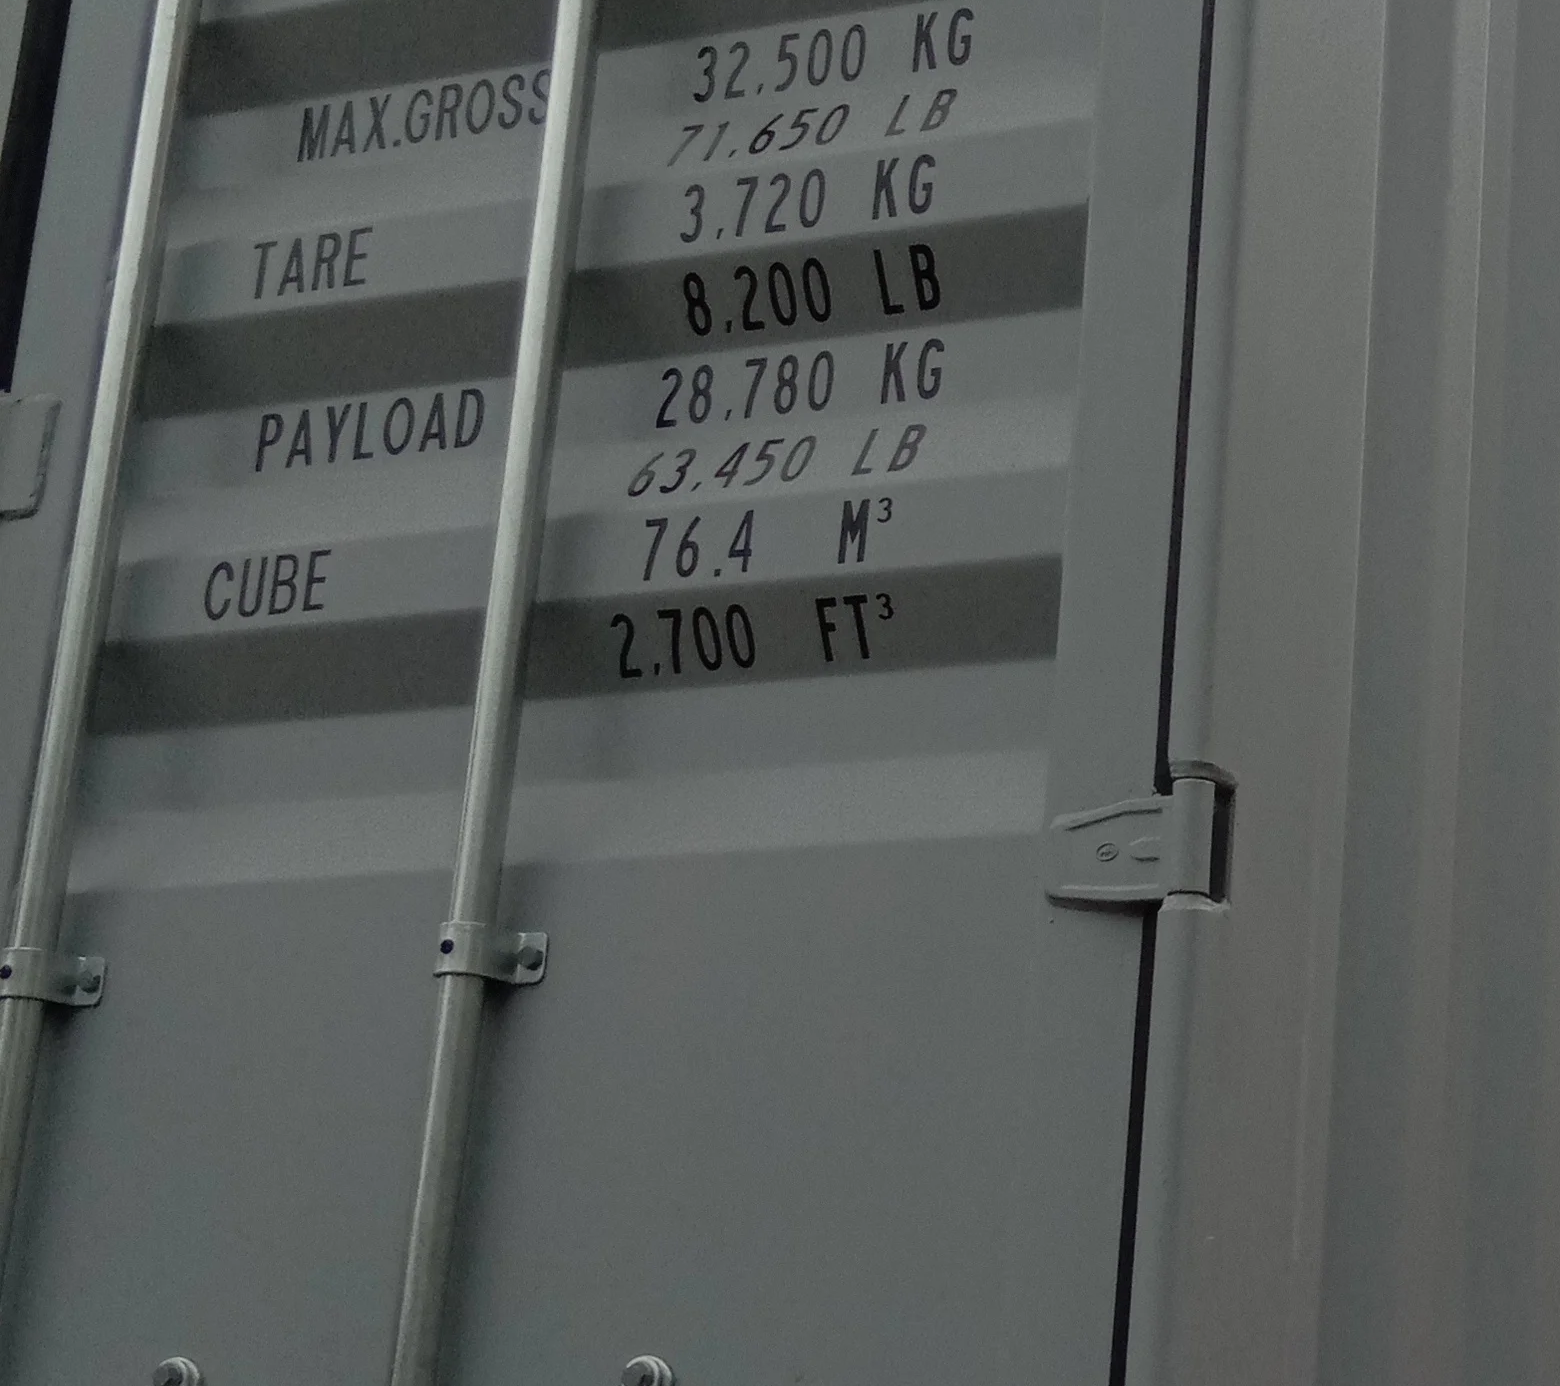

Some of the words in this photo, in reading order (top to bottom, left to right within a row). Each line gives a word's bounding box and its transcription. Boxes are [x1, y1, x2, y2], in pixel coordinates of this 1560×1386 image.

[297, 67, 552, 163] MAX.GROSS
[911, 7, 975, 73] KG
[884, 88, 958, 138] LB
[252, 226, 374, 302] TARE
[871, 153, 936, 221] KG
[873, 243, 941, 316] LB
[254, 387, 486, 473] PAYLOAD
[880, 338, 946, 405] KG
[850, 423, 928, 477] LB
[203, 548, 332, 621] CUBE
[642, 508, 755, 582] 76.4
